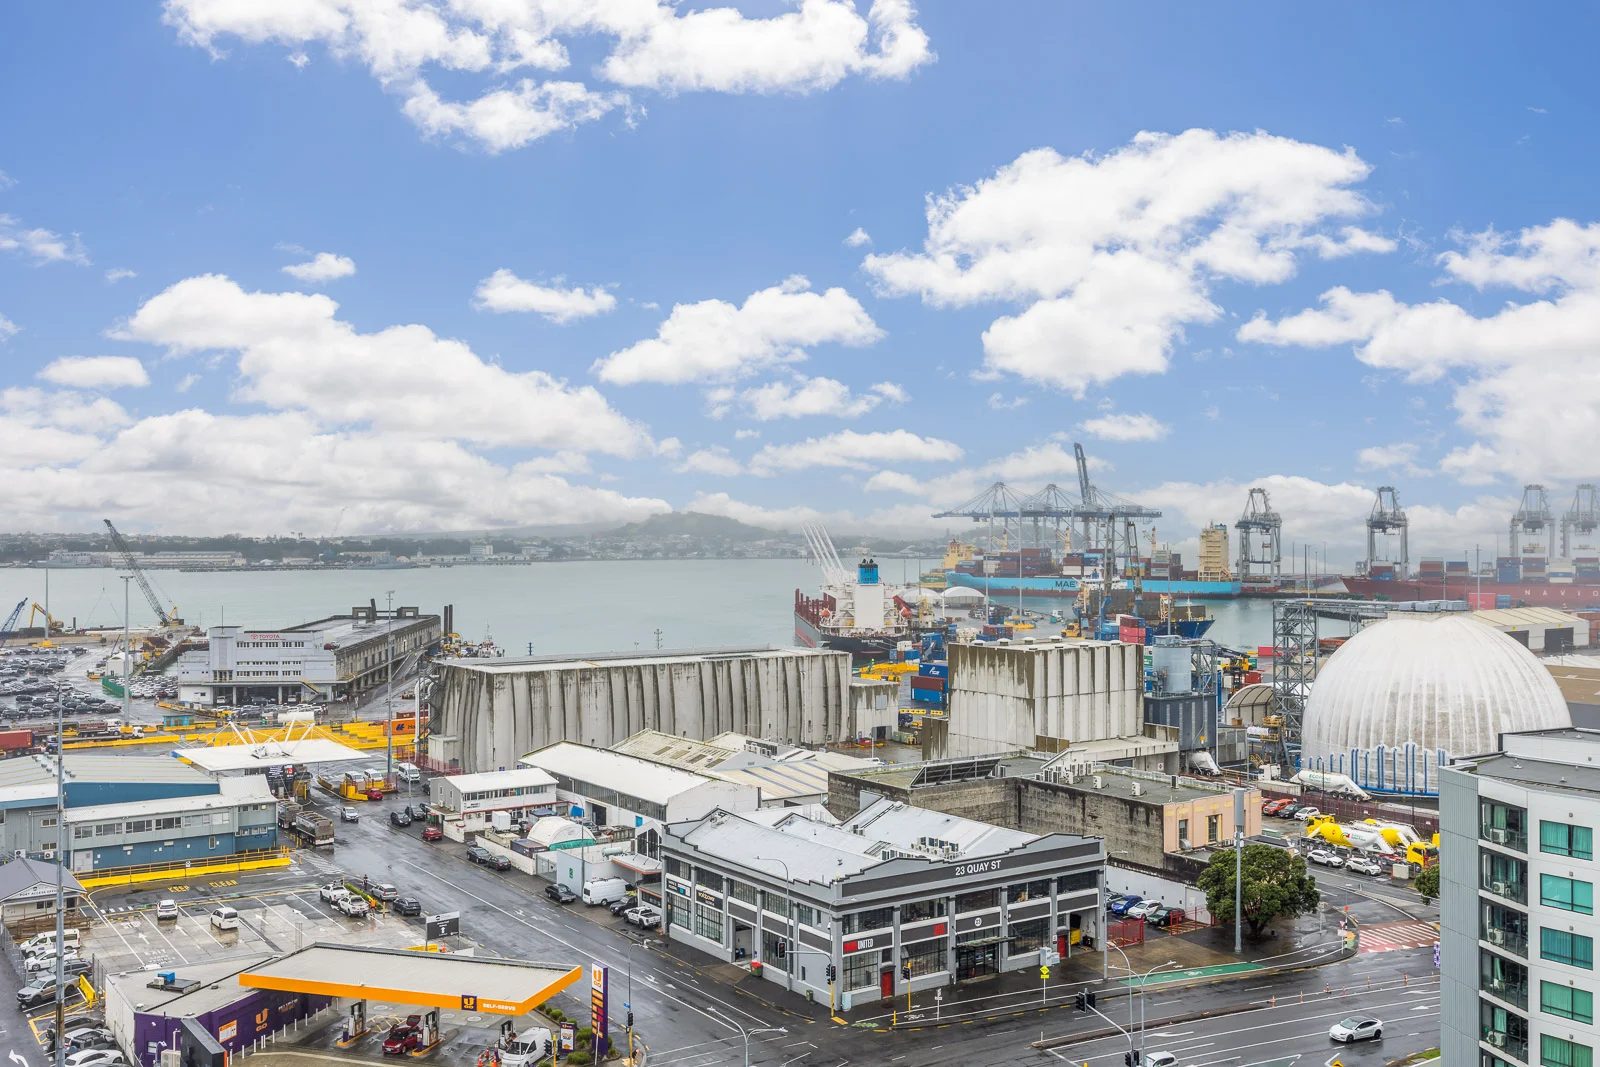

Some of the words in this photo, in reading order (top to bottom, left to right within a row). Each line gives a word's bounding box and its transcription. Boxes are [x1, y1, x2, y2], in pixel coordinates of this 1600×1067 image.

[955, 866, 965, 876] 23
[966, 862, 990, 874] QUAY
[990, 860, 1002, 870] ST
[167, 885, 190, 893] KEEP
[208, 879, 239, 888] CLEAR
[857, 938, 874, 950] UNITED
[482, 1003, 516, 1011] SELF-SERVE
